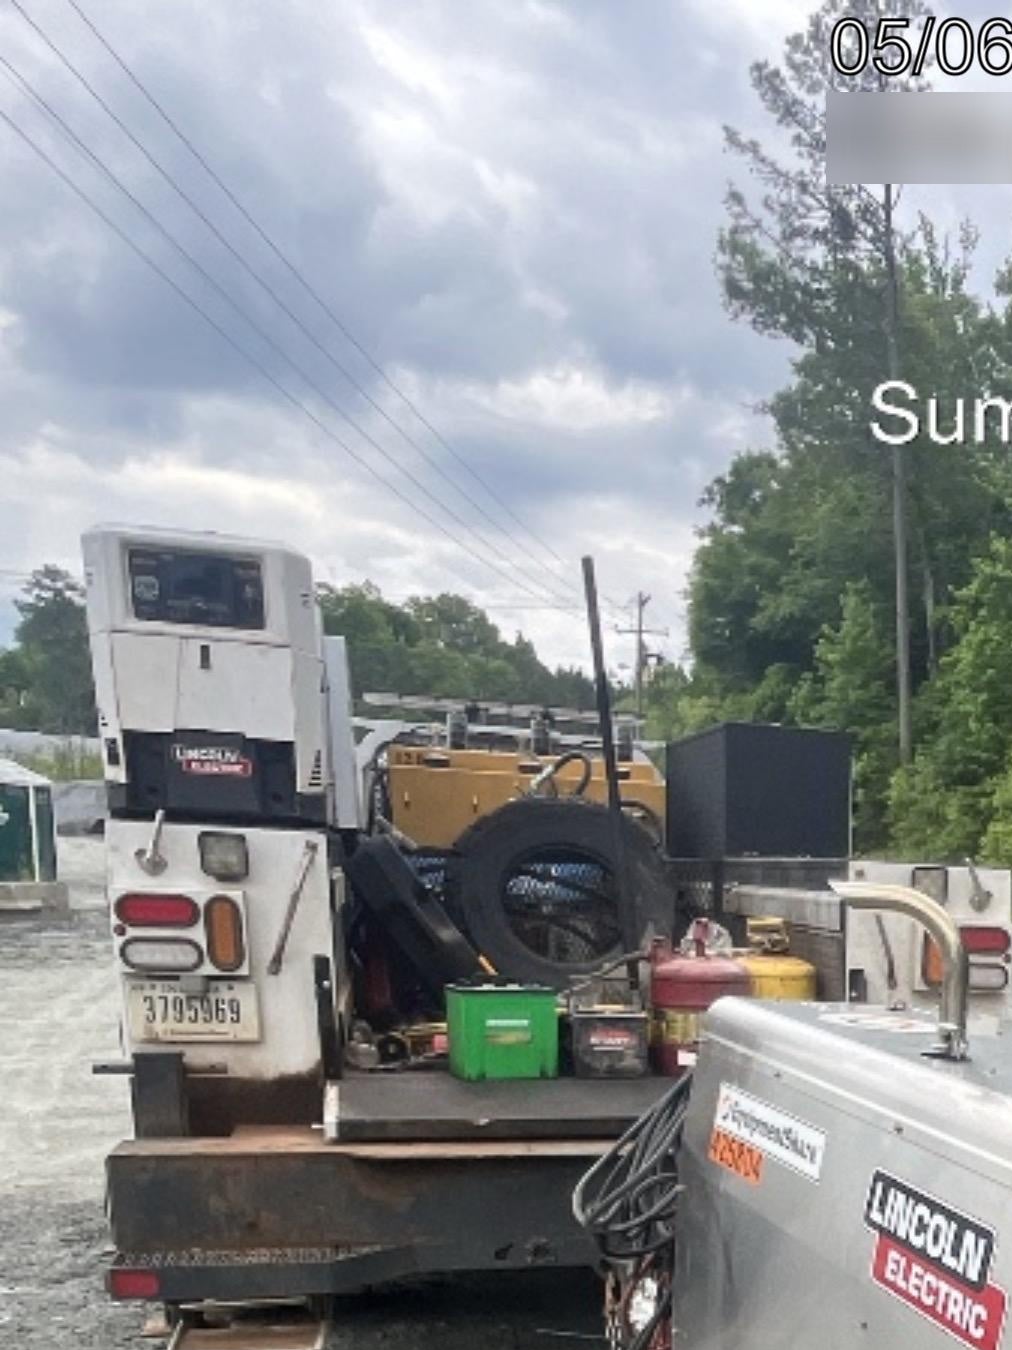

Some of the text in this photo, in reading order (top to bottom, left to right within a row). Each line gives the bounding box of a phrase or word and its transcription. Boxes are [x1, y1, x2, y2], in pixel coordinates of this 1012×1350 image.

[143, 995, 241, 1024] 3795969
[869, 1181, 988, 1282] LINCOLN
[884, 1250, 988, 1339] ELECTRIC
